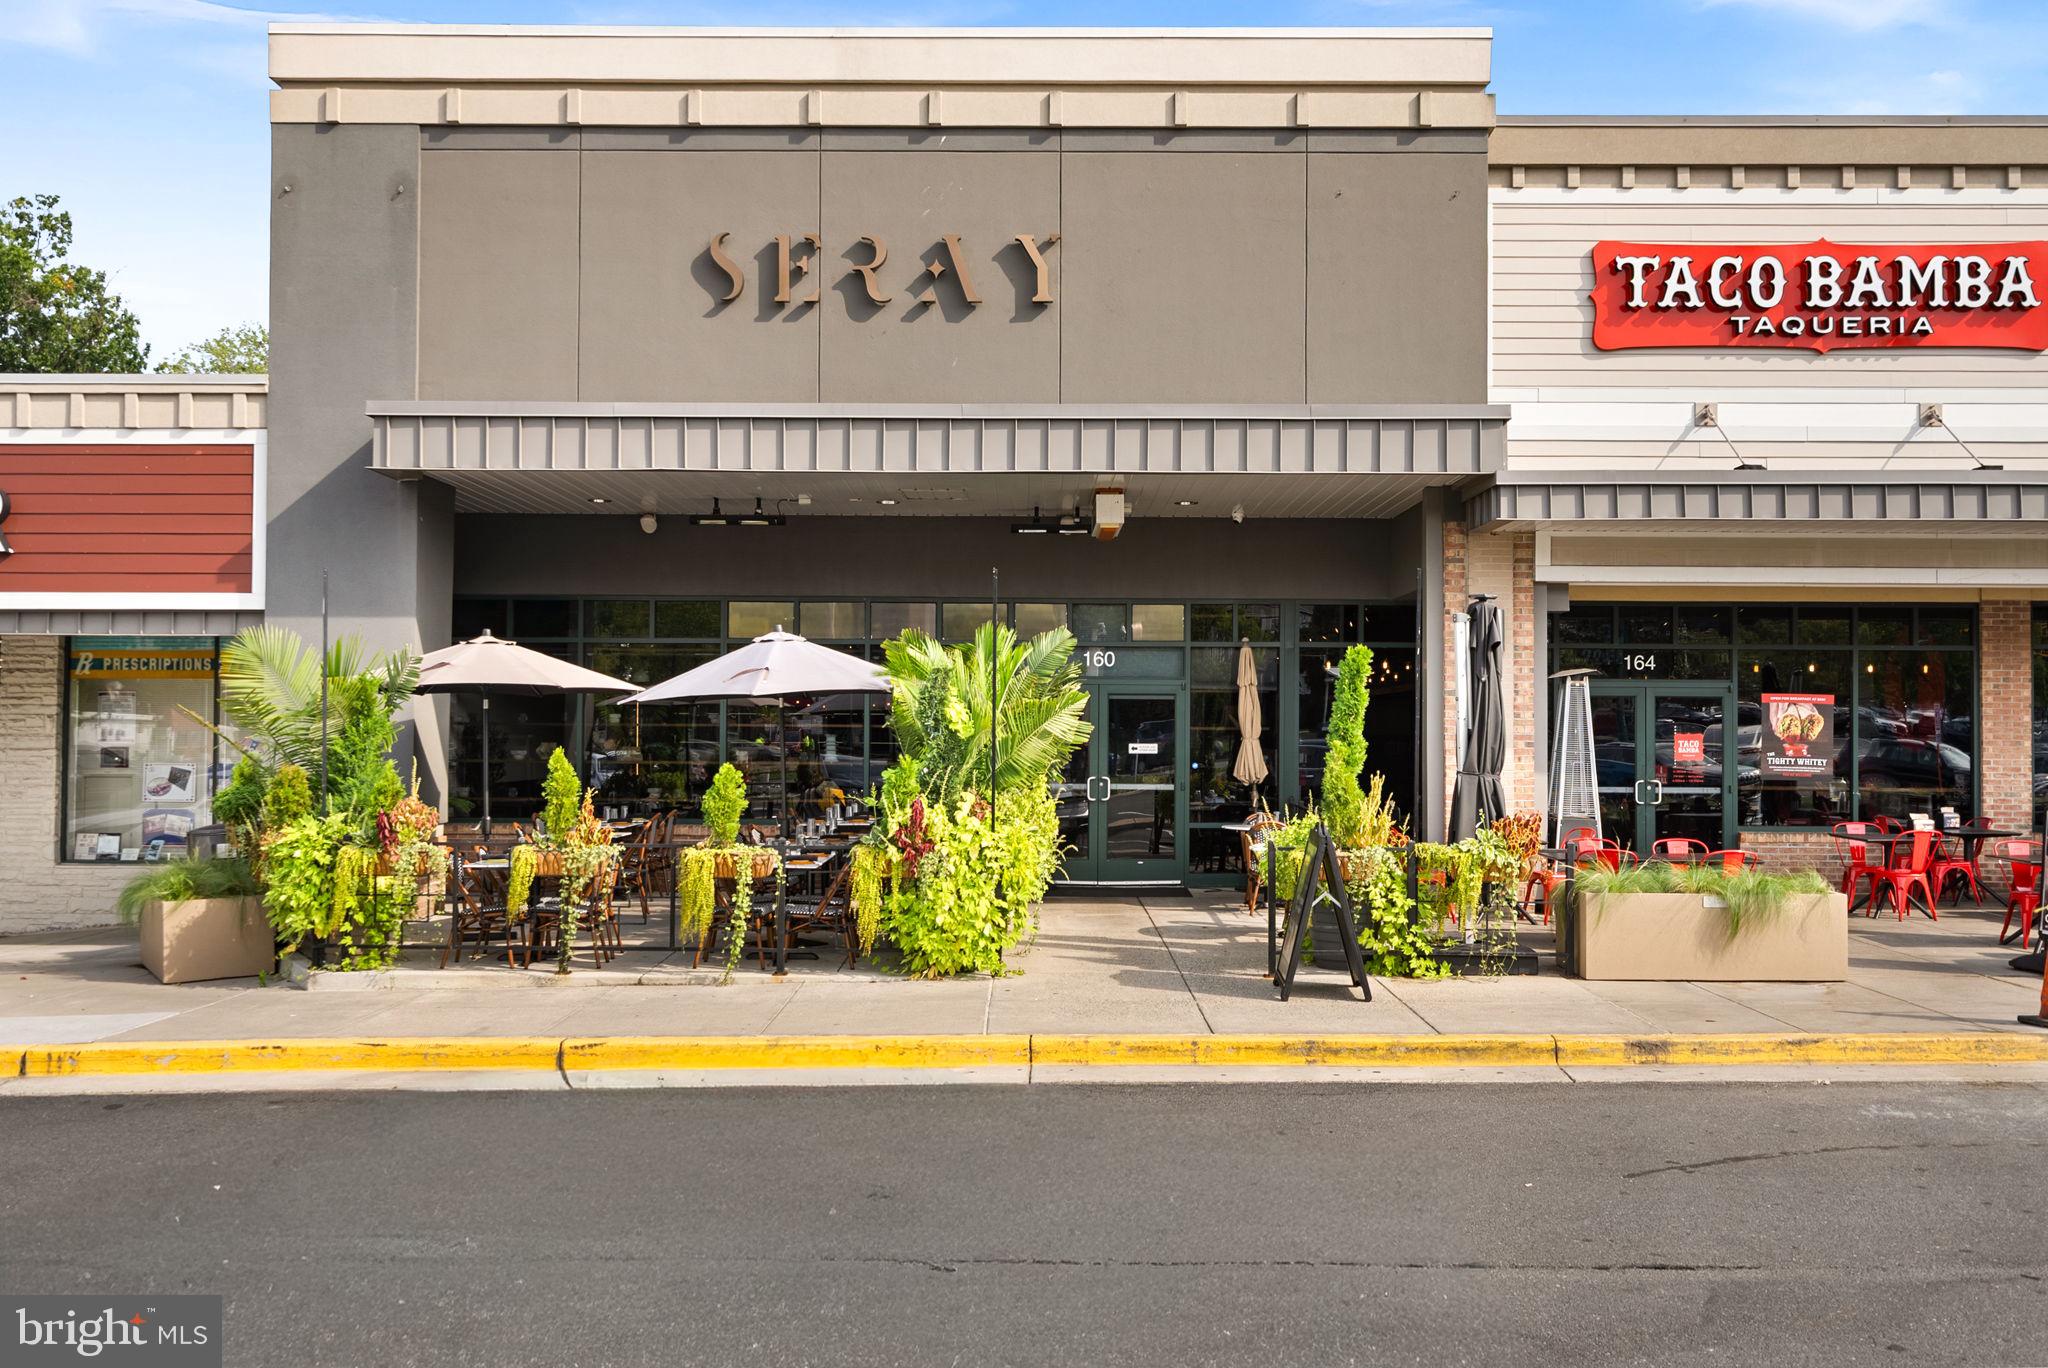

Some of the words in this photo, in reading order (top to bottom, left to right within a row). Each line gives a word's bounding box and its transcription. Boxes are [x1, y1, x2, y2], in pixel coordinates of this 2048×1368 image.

[710, 232, 1061, 305] SERAY
[1614, 255, 1789, 308] TACO
[1803, 254, 2042, 309] BAMBA
[1730, 316, 1935, 336] TAQUERIA
[103, 657, 212, 671] PRESCRIPTIONS
[1083, 651, 1116, 667] 160
[1623, 654, 1657, 671] 164
[1678, 740, 1700, 748] TACO
[1767, 757, 1796, 765] TIGHTY
[1796, 758, 1828, 766] WHITEY
